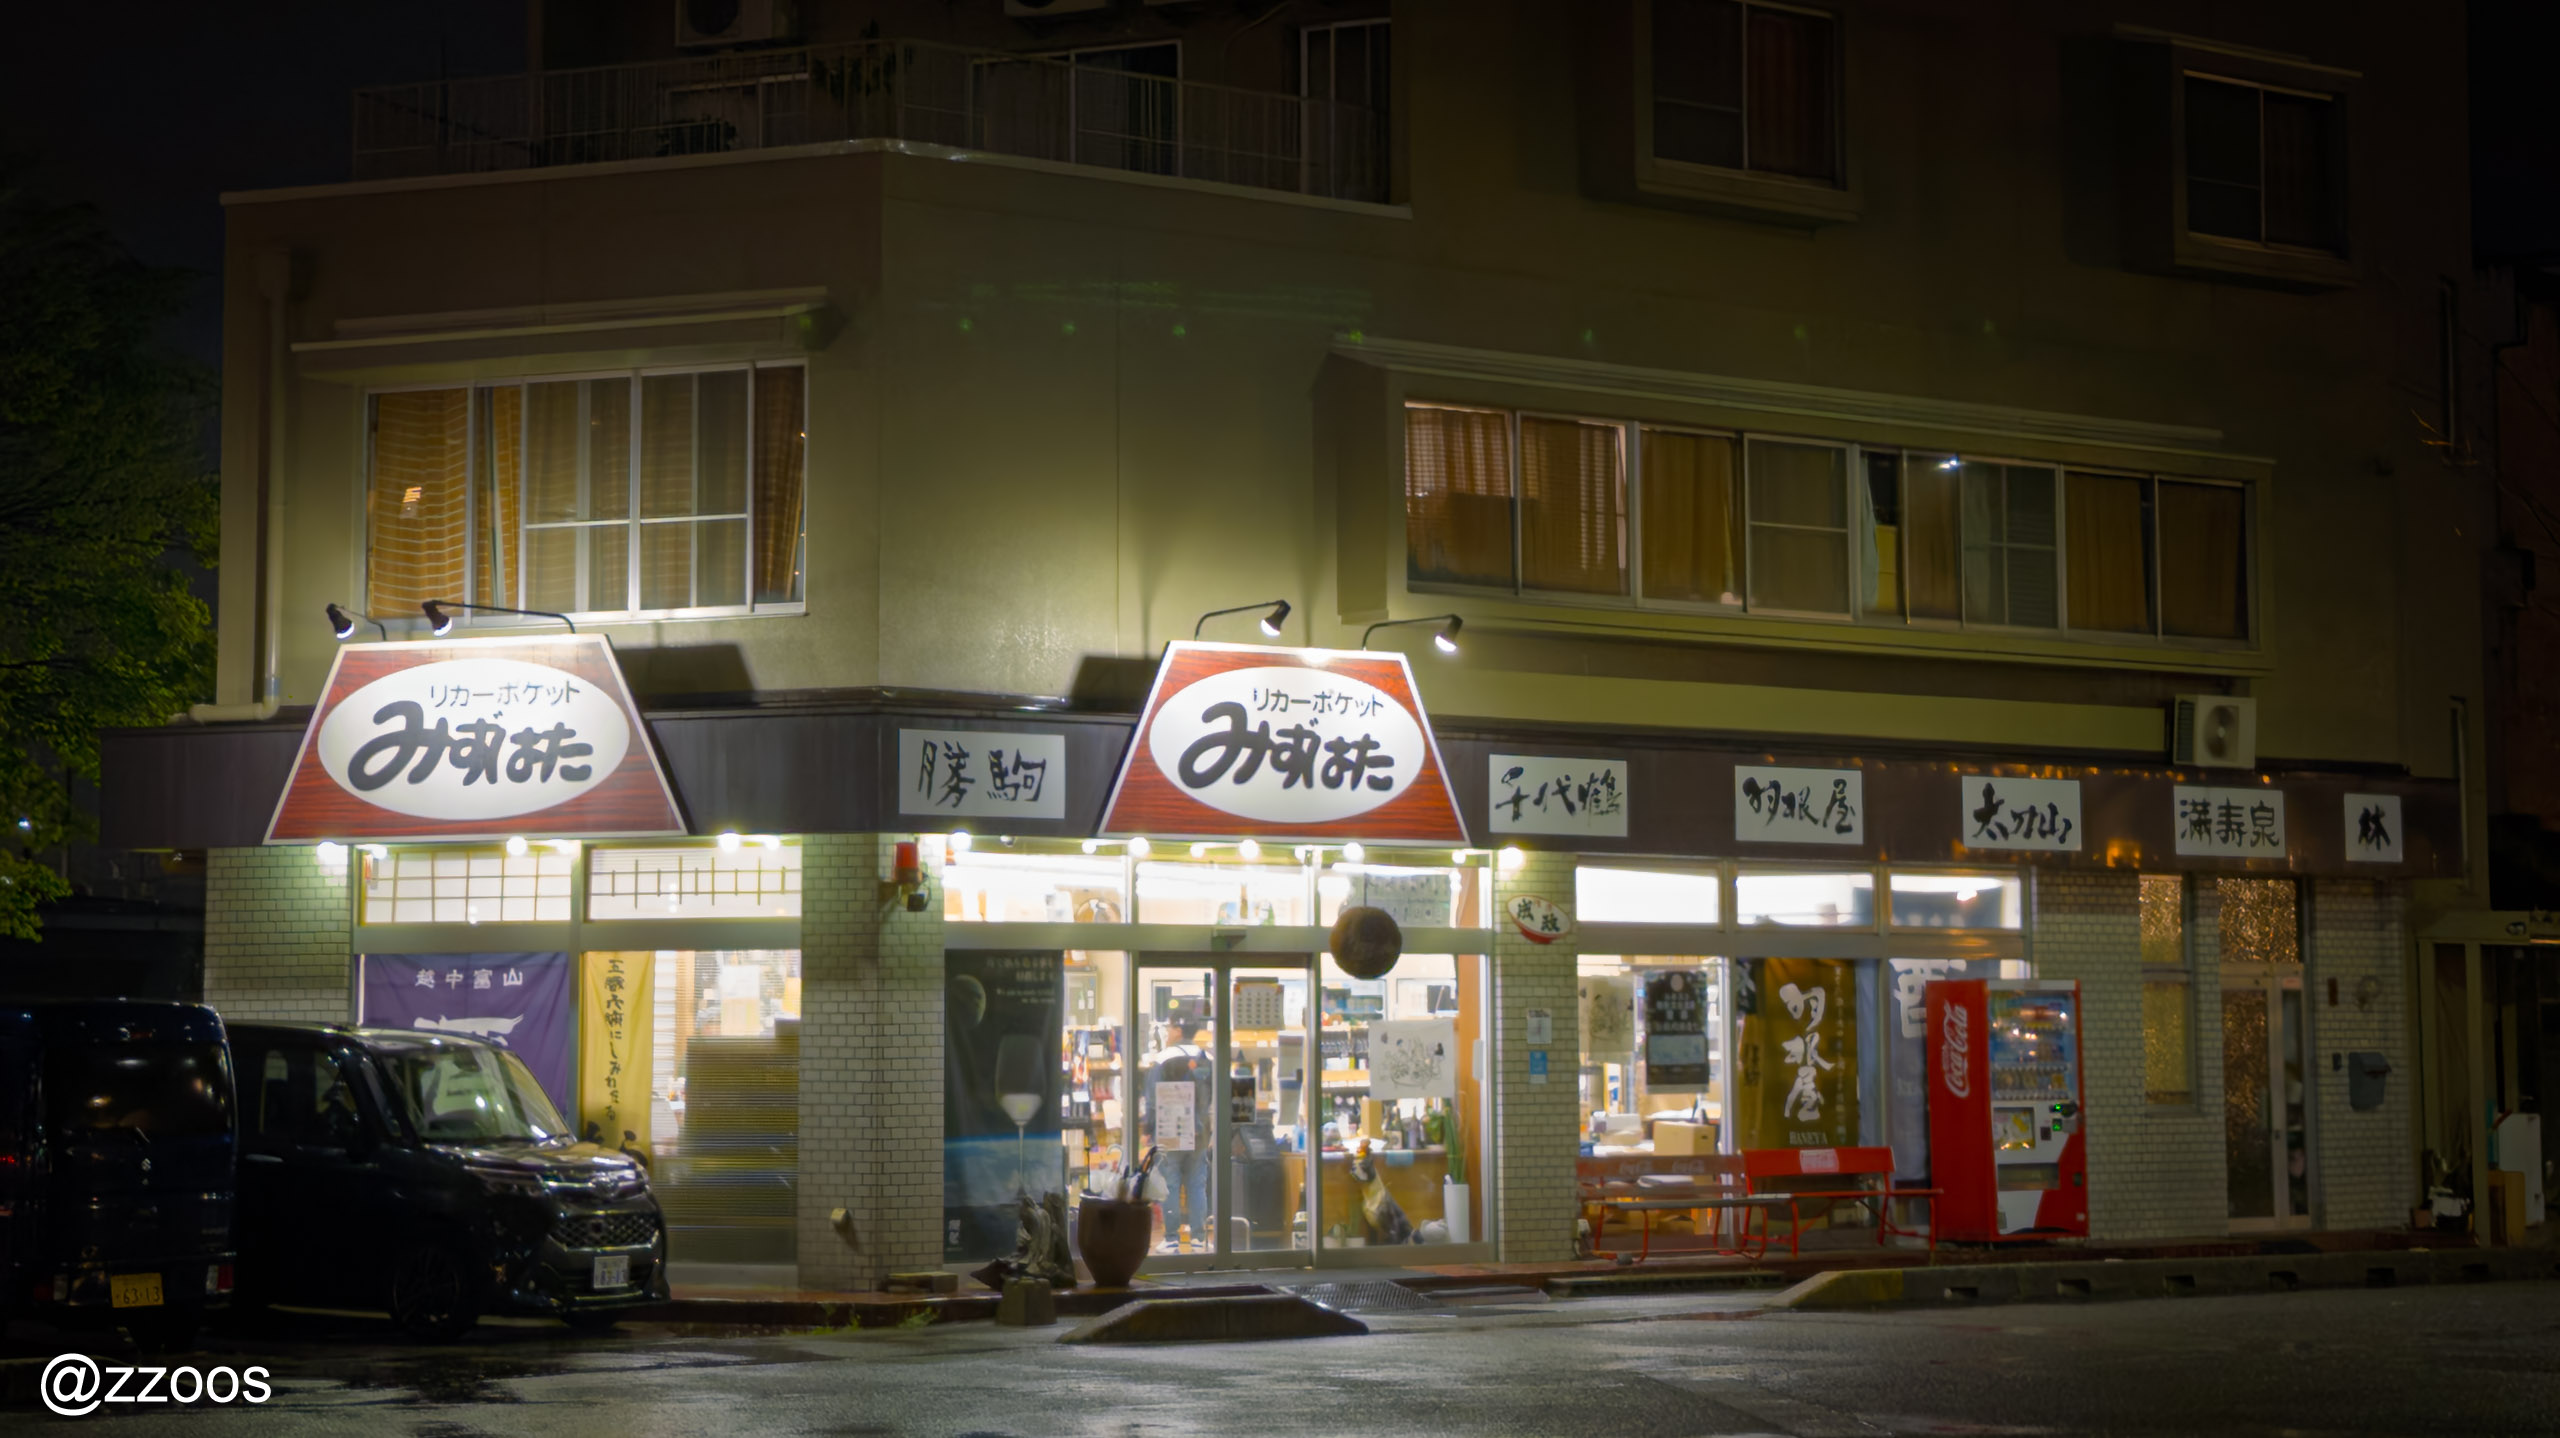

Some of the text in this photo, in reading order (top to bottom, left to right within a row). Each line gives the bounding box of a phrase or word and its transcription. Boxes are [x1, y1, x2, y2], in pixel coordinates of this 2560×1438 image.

[1253, 687, 1384, 717] リカーポケット
[917, 739, 1047, 808] 勝駒
[1495, 766, 1622, 828] 千代鶴
[1742, 777, 1856, 834] 羽根屋
[2358, 802, 2391, 851] 林
[415, 967, 523, 990] 越中富山
[1778, 983, 1836, 1122] 羽根屋
